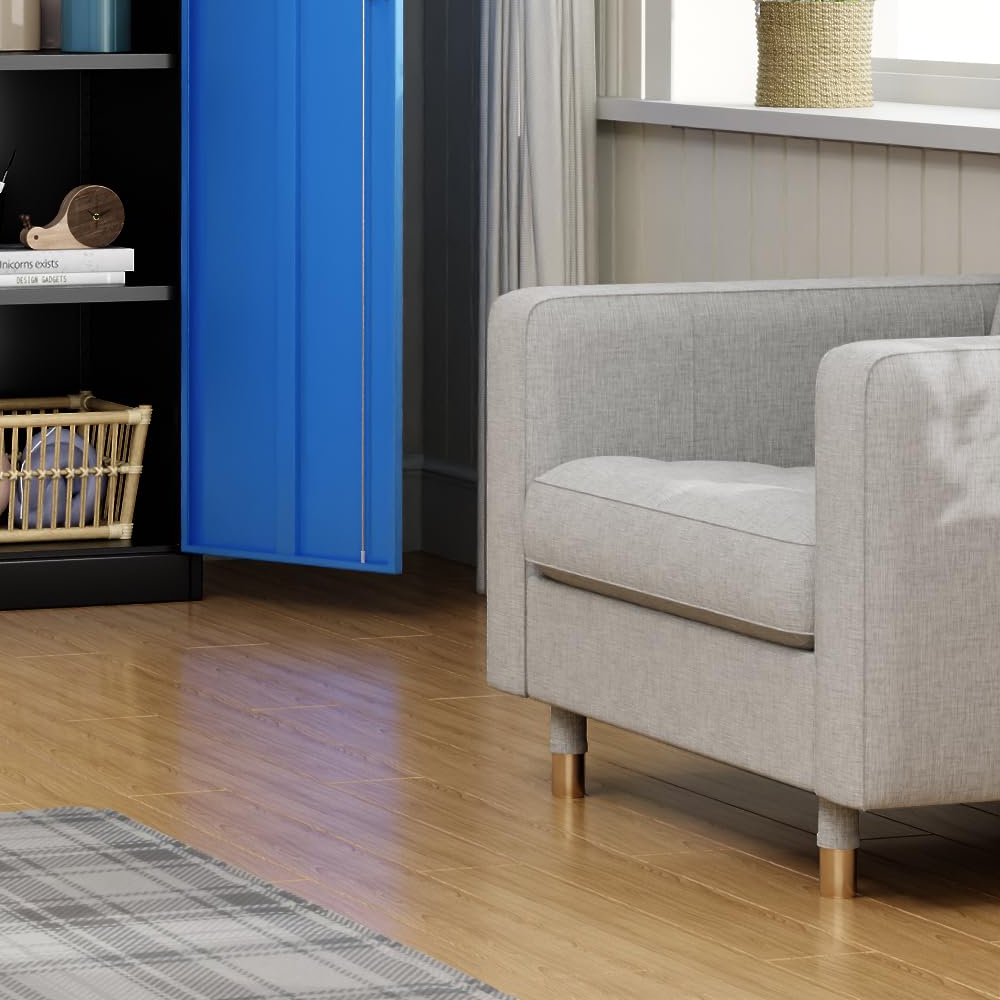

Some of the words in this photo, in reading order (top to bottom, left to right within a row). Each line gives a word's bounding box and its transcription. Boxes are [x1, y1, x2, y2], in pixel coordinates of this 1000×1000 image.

[34, 258, 59, 269] exists
[16, 276, 39, 284] DESIGN
[41, 275, 67, 284] GADGETS
